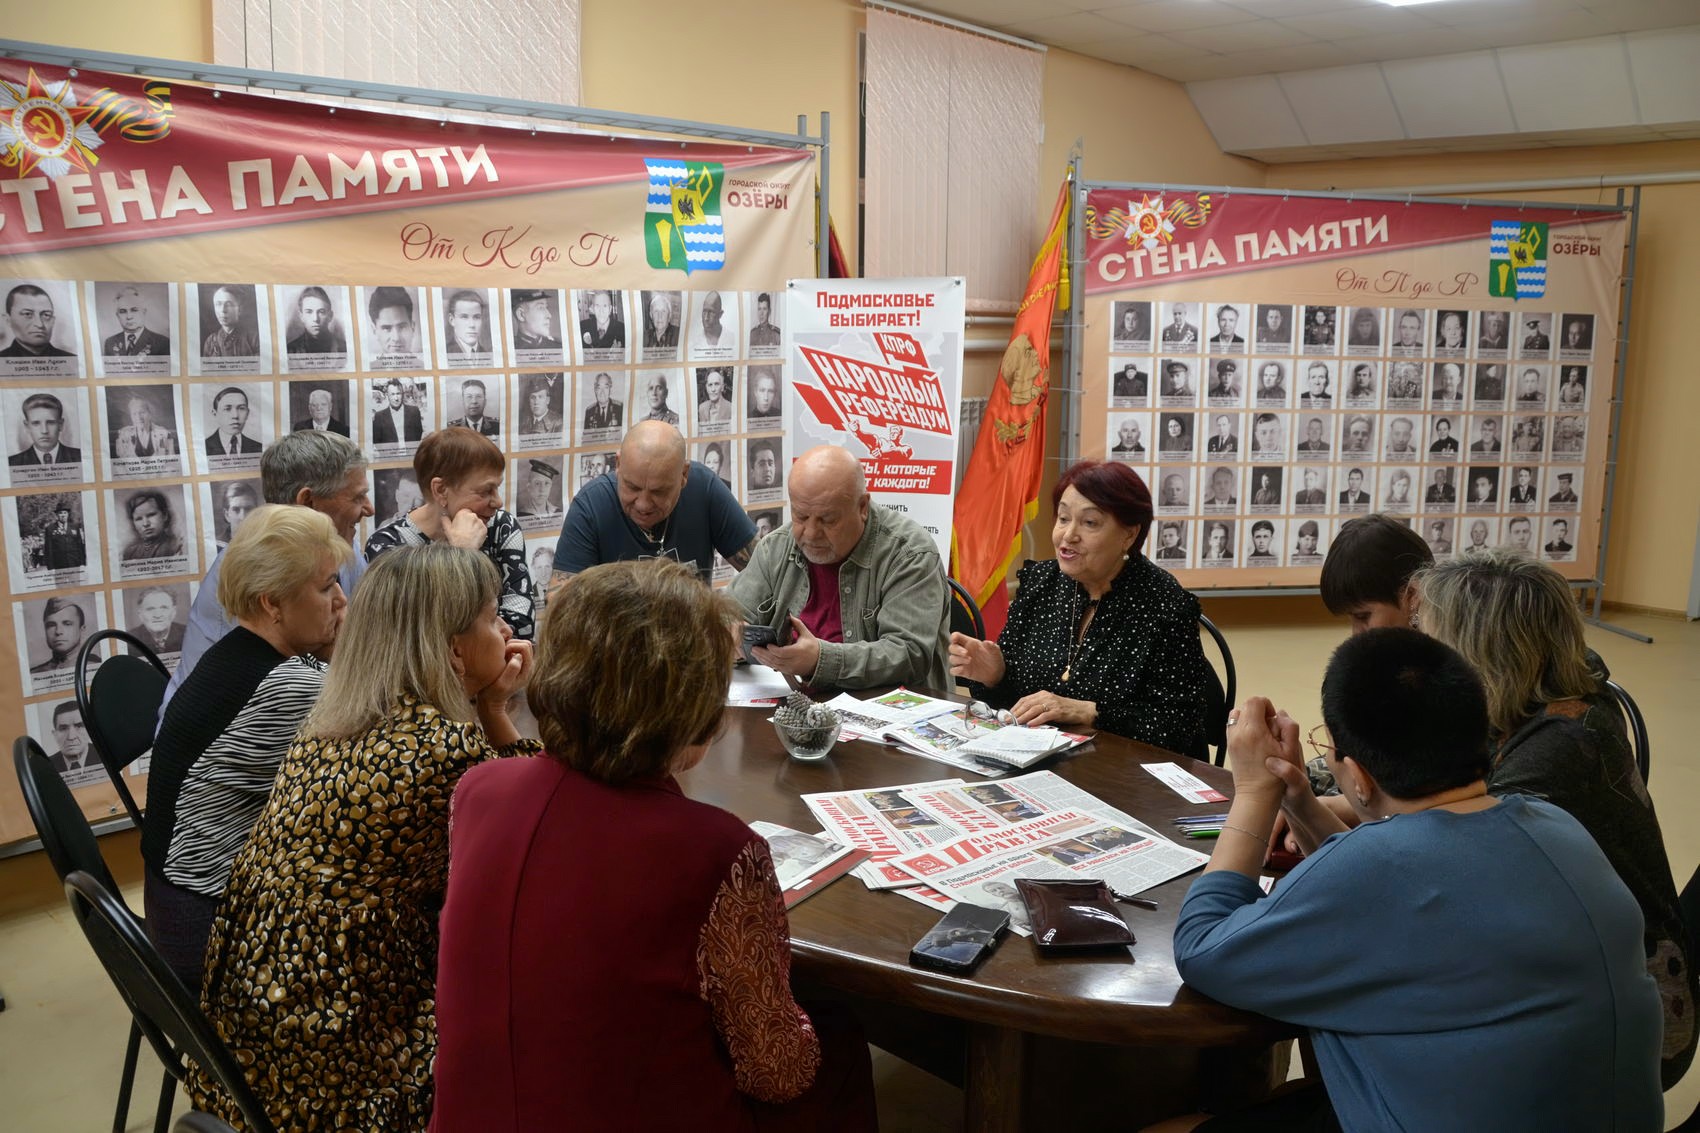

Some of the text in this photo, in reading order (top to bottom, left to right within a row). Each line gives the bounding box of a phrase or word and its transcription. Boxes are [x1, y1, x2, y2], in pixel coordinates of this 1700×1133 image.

[0, 143, 500, 233] ТЕНА ПАМЯТИ
[729, 179, 769, 188] ГОРОДСКОЙ
[728, 188, 788, 209] ОЗЁРЫ
[401, 222, 620, 275] От К до П
[1098, 214, 1389, 282] СТЕНА ПАМЯТИ
[1553, 240, 1600, 256] ОЗЁРЫ
[1336, 267, 1369, 291] От
[1374, 269, 1411, 293] П
[1438, 272, 1479, 296] Я
[830, 309, 921, 327] ВЫБИРАЕТ!
[879, 332, 917, 357] КПРФ
[811, 352, 944, 409] НАРОДНЫЙ
[834, 389, 949, 431] РЕФЕРЕНДУМ
[883, 464, 938, 476] КОТОРЫЕ
[874, 477, 931, 489] КАЖДОГО!
